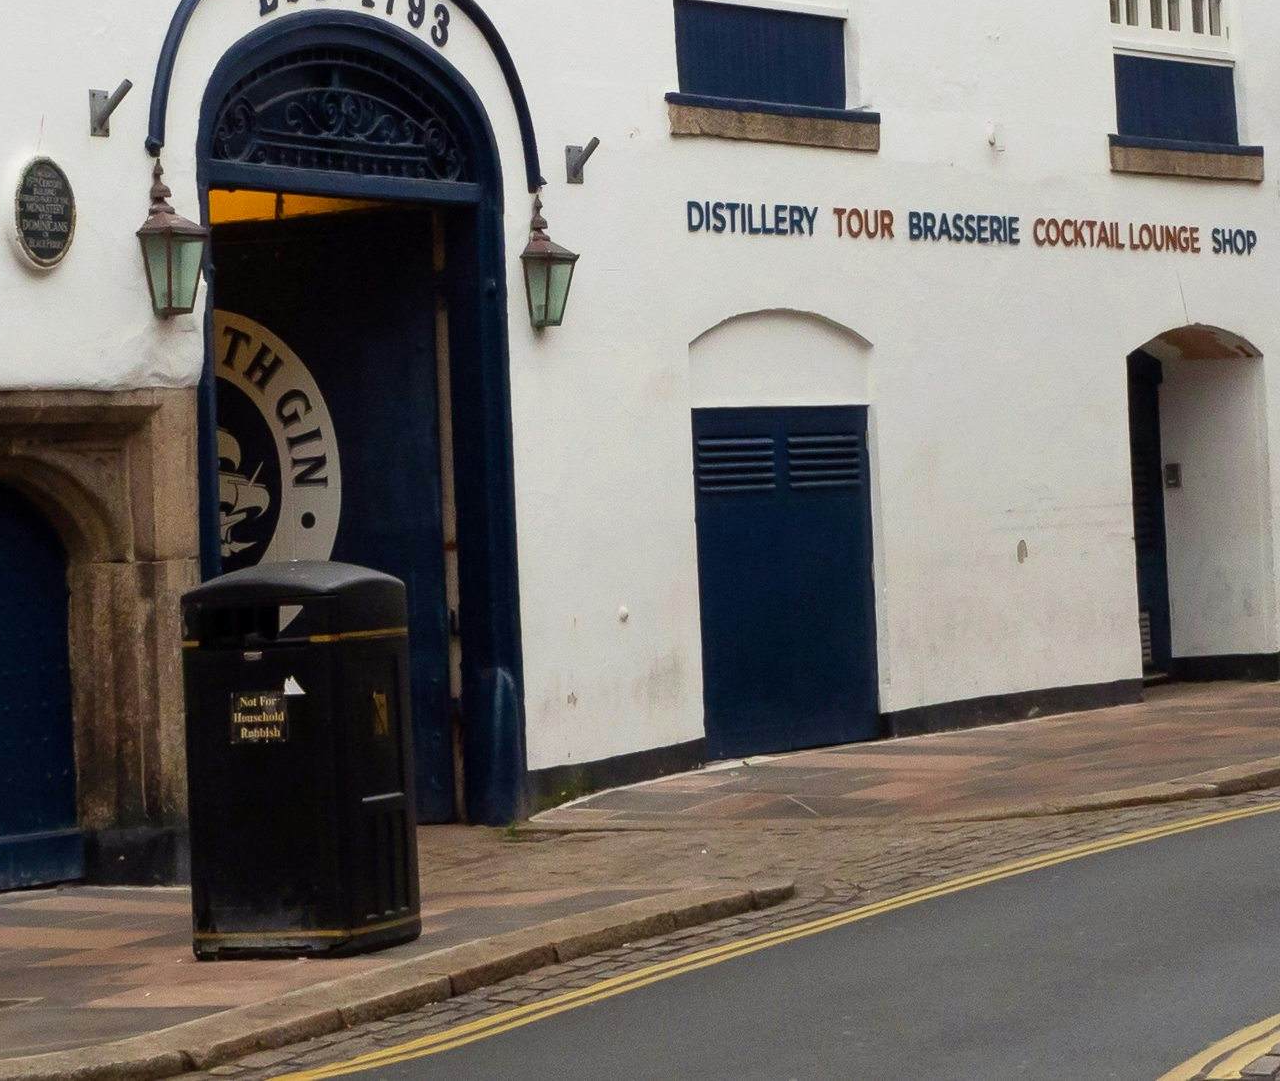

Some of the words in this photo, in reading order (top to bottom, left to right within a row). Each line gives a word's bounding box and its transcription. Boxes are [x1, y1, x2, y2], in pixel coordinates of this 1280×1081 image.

[686, 200, 819, 236] DISTILLERY
[832, 207, 895, 239] TOUR
[908, 211, 1021, 245] BRASSERIE
[1033, 217, 1125, 250] COCKTAIL
[1128, 221, 1201, 254] LOUNGE
[1211, 227, 1258, 257] SHOP
[275, 388, 329, 488] GIN
[240, 697, 257, 707] Not
[260, 695, 276, 706] For
[233, 711, 285, 723] Household
[241, 726, 281, 738] Rubbish
